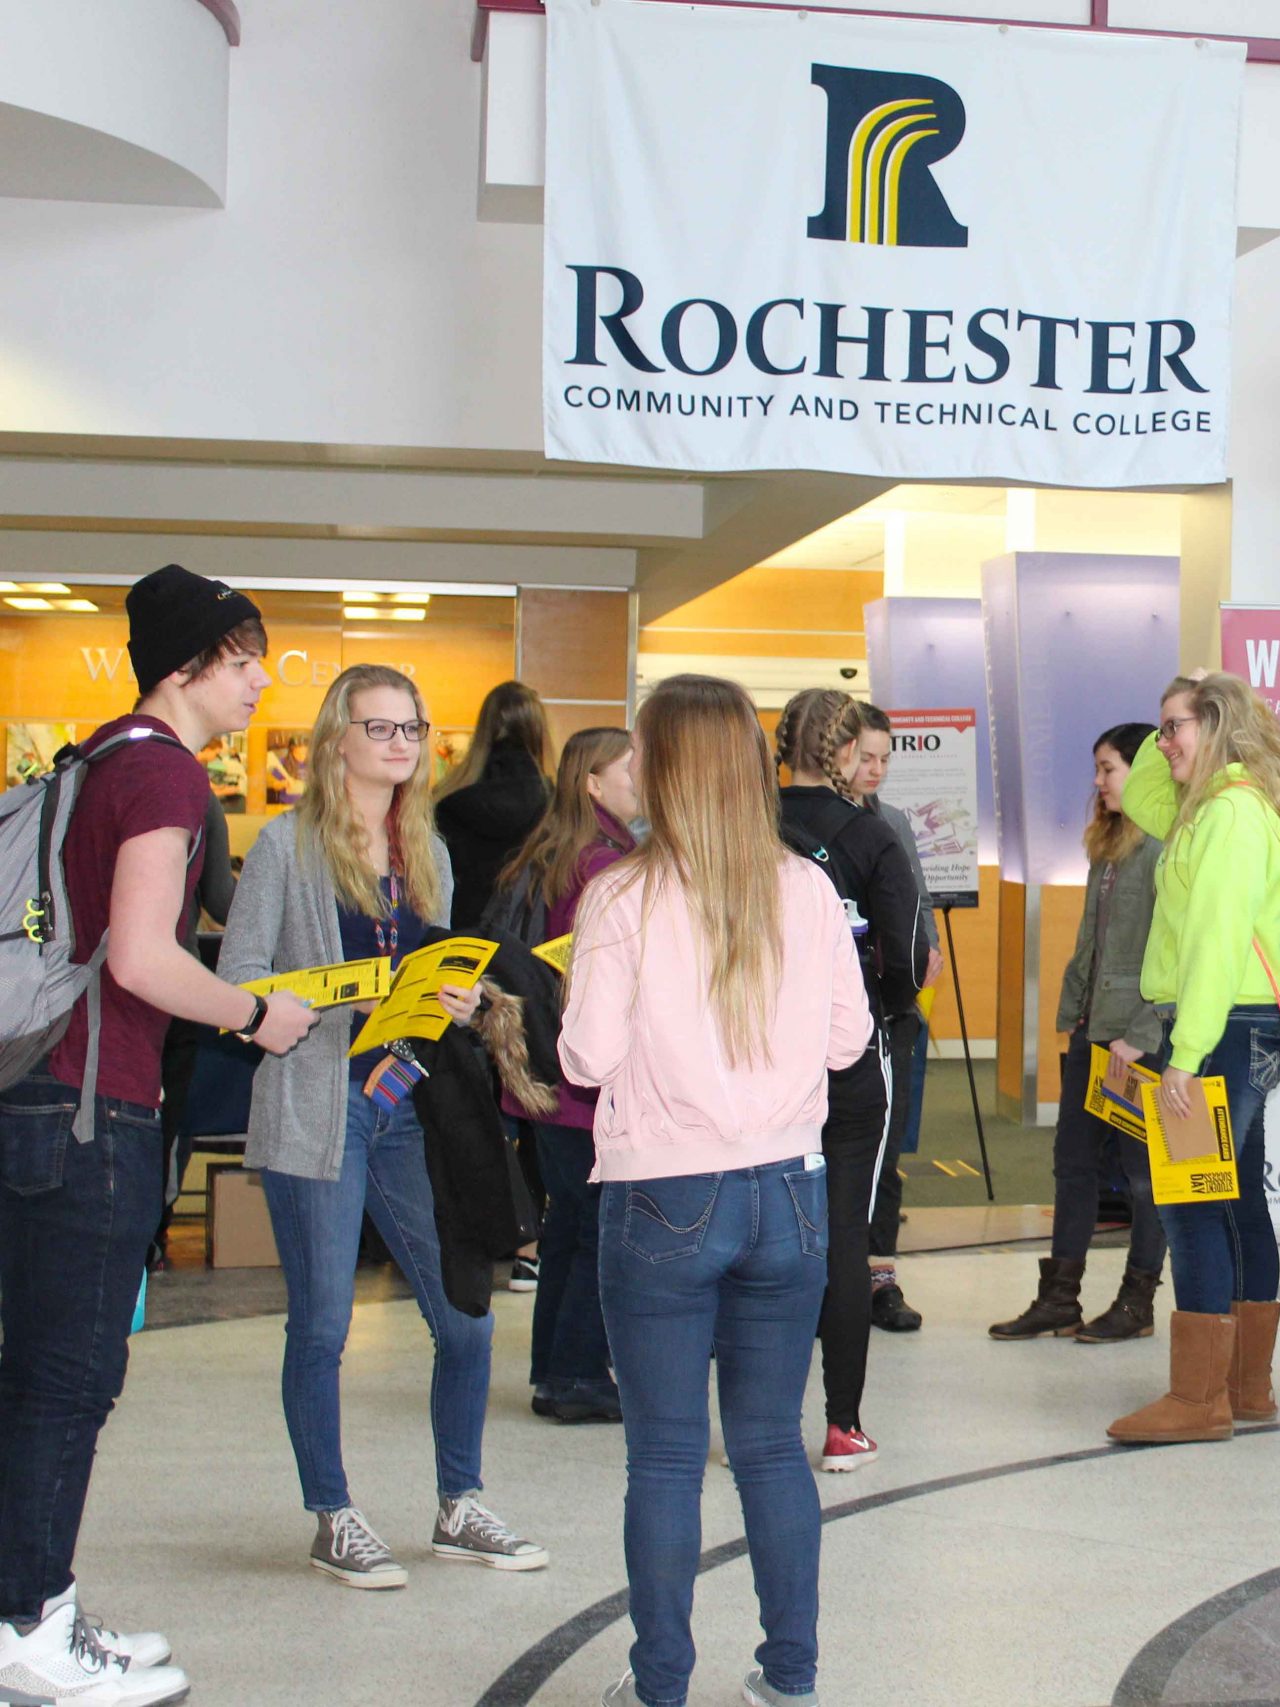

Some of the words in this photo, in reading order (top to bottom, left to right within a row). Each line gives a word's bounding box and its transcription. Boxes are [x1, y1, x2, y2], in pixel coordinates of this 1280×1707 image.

[807, 62, 968, 248] R
[564, 263, 1211, 395] ROCHESTER
[564, 384, 775, 418] COMMUNITY
[789, 394, 860, 422] AND
[875, 401, 1058, 432] TECHNICAL
[1073, 409, 1212, 436] COLLEGE
[890, 734, 941, 752] TRIO
[1190, 1173, 1205, 1194] DAY
